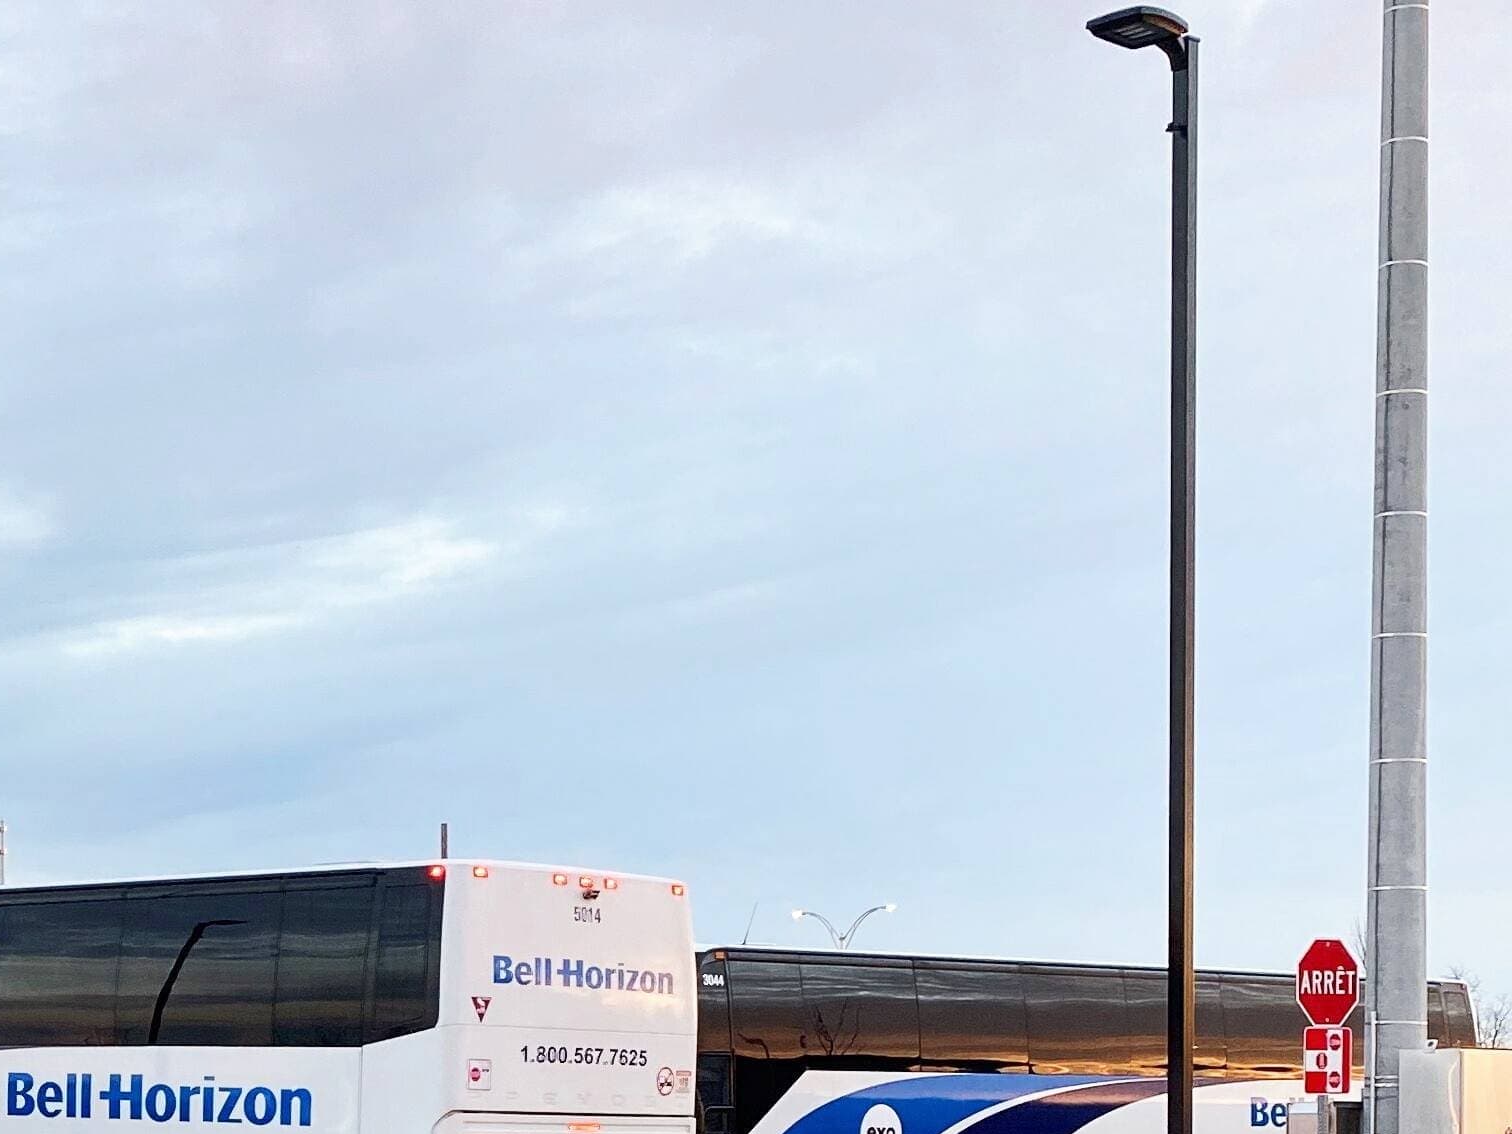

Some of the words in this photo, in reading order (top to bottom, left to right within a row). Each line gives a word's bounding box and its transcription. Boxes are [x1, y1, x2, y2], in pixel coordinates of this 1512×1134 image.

[574, 906, 601, 924] 5014
[702, 973, 725, 987] 3044
[1300, 965, 1355, 995] ARRÊT
[520, 1045, 648, 1067] 1.800.567.7625
